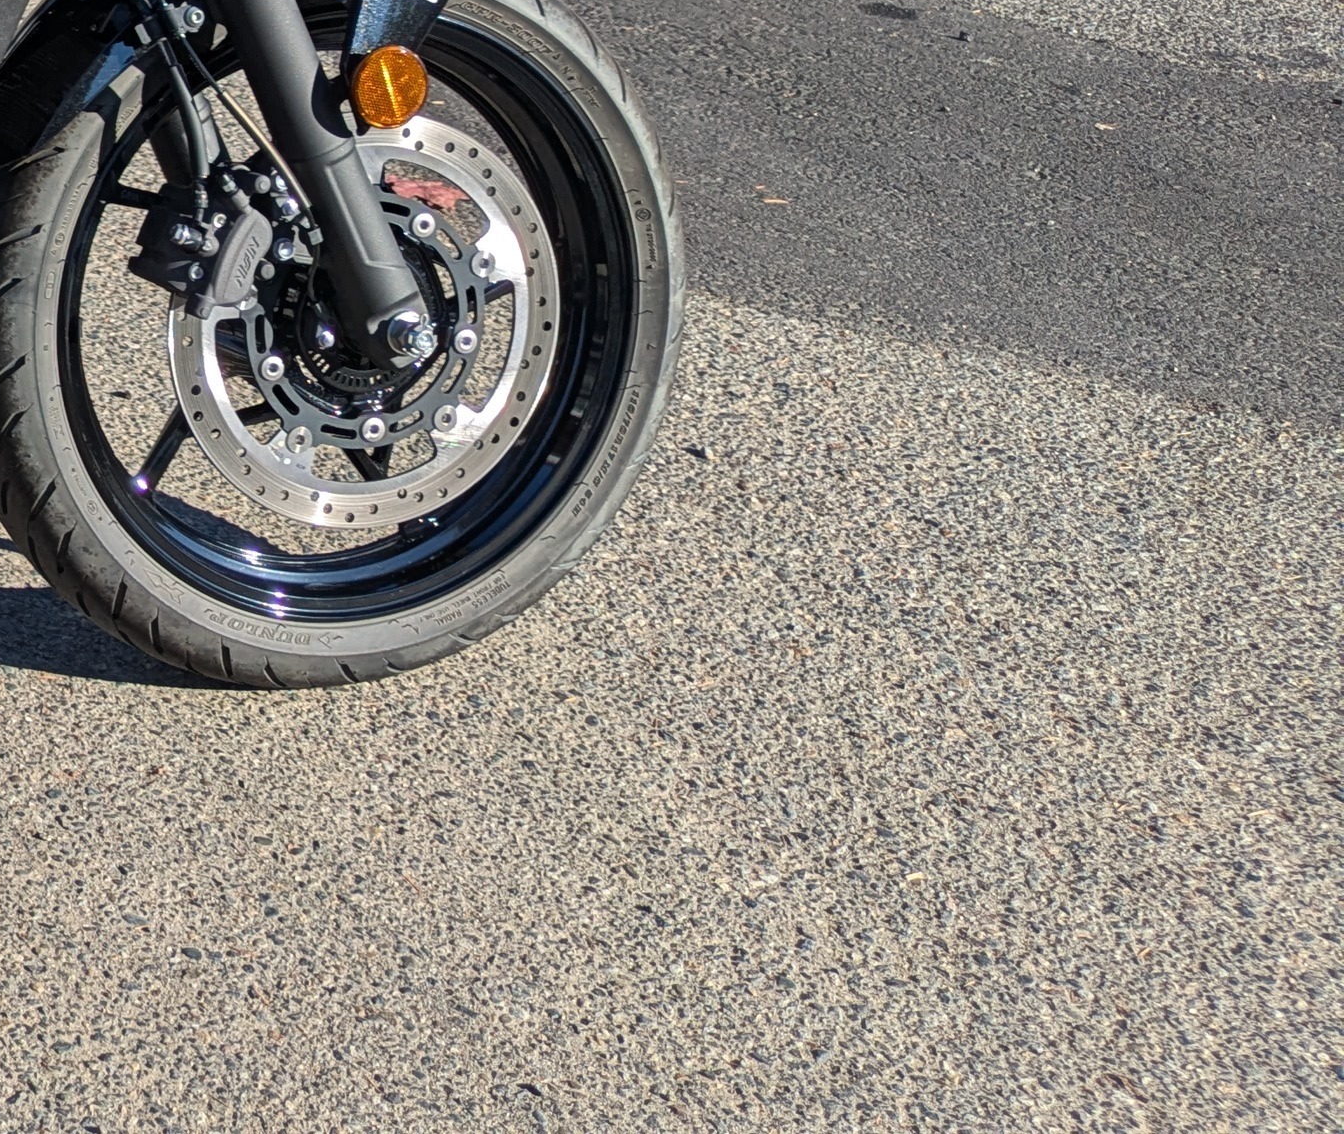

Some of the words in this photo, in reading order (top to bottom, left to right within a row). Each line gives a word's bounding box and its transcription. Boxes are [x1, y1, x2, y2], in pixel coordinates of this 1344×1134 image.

[469, 579, 511, 608] TUBELESS
[210, 614, 311, 648] DUNLOP
[433, 606, 462, 629] RADIAL
